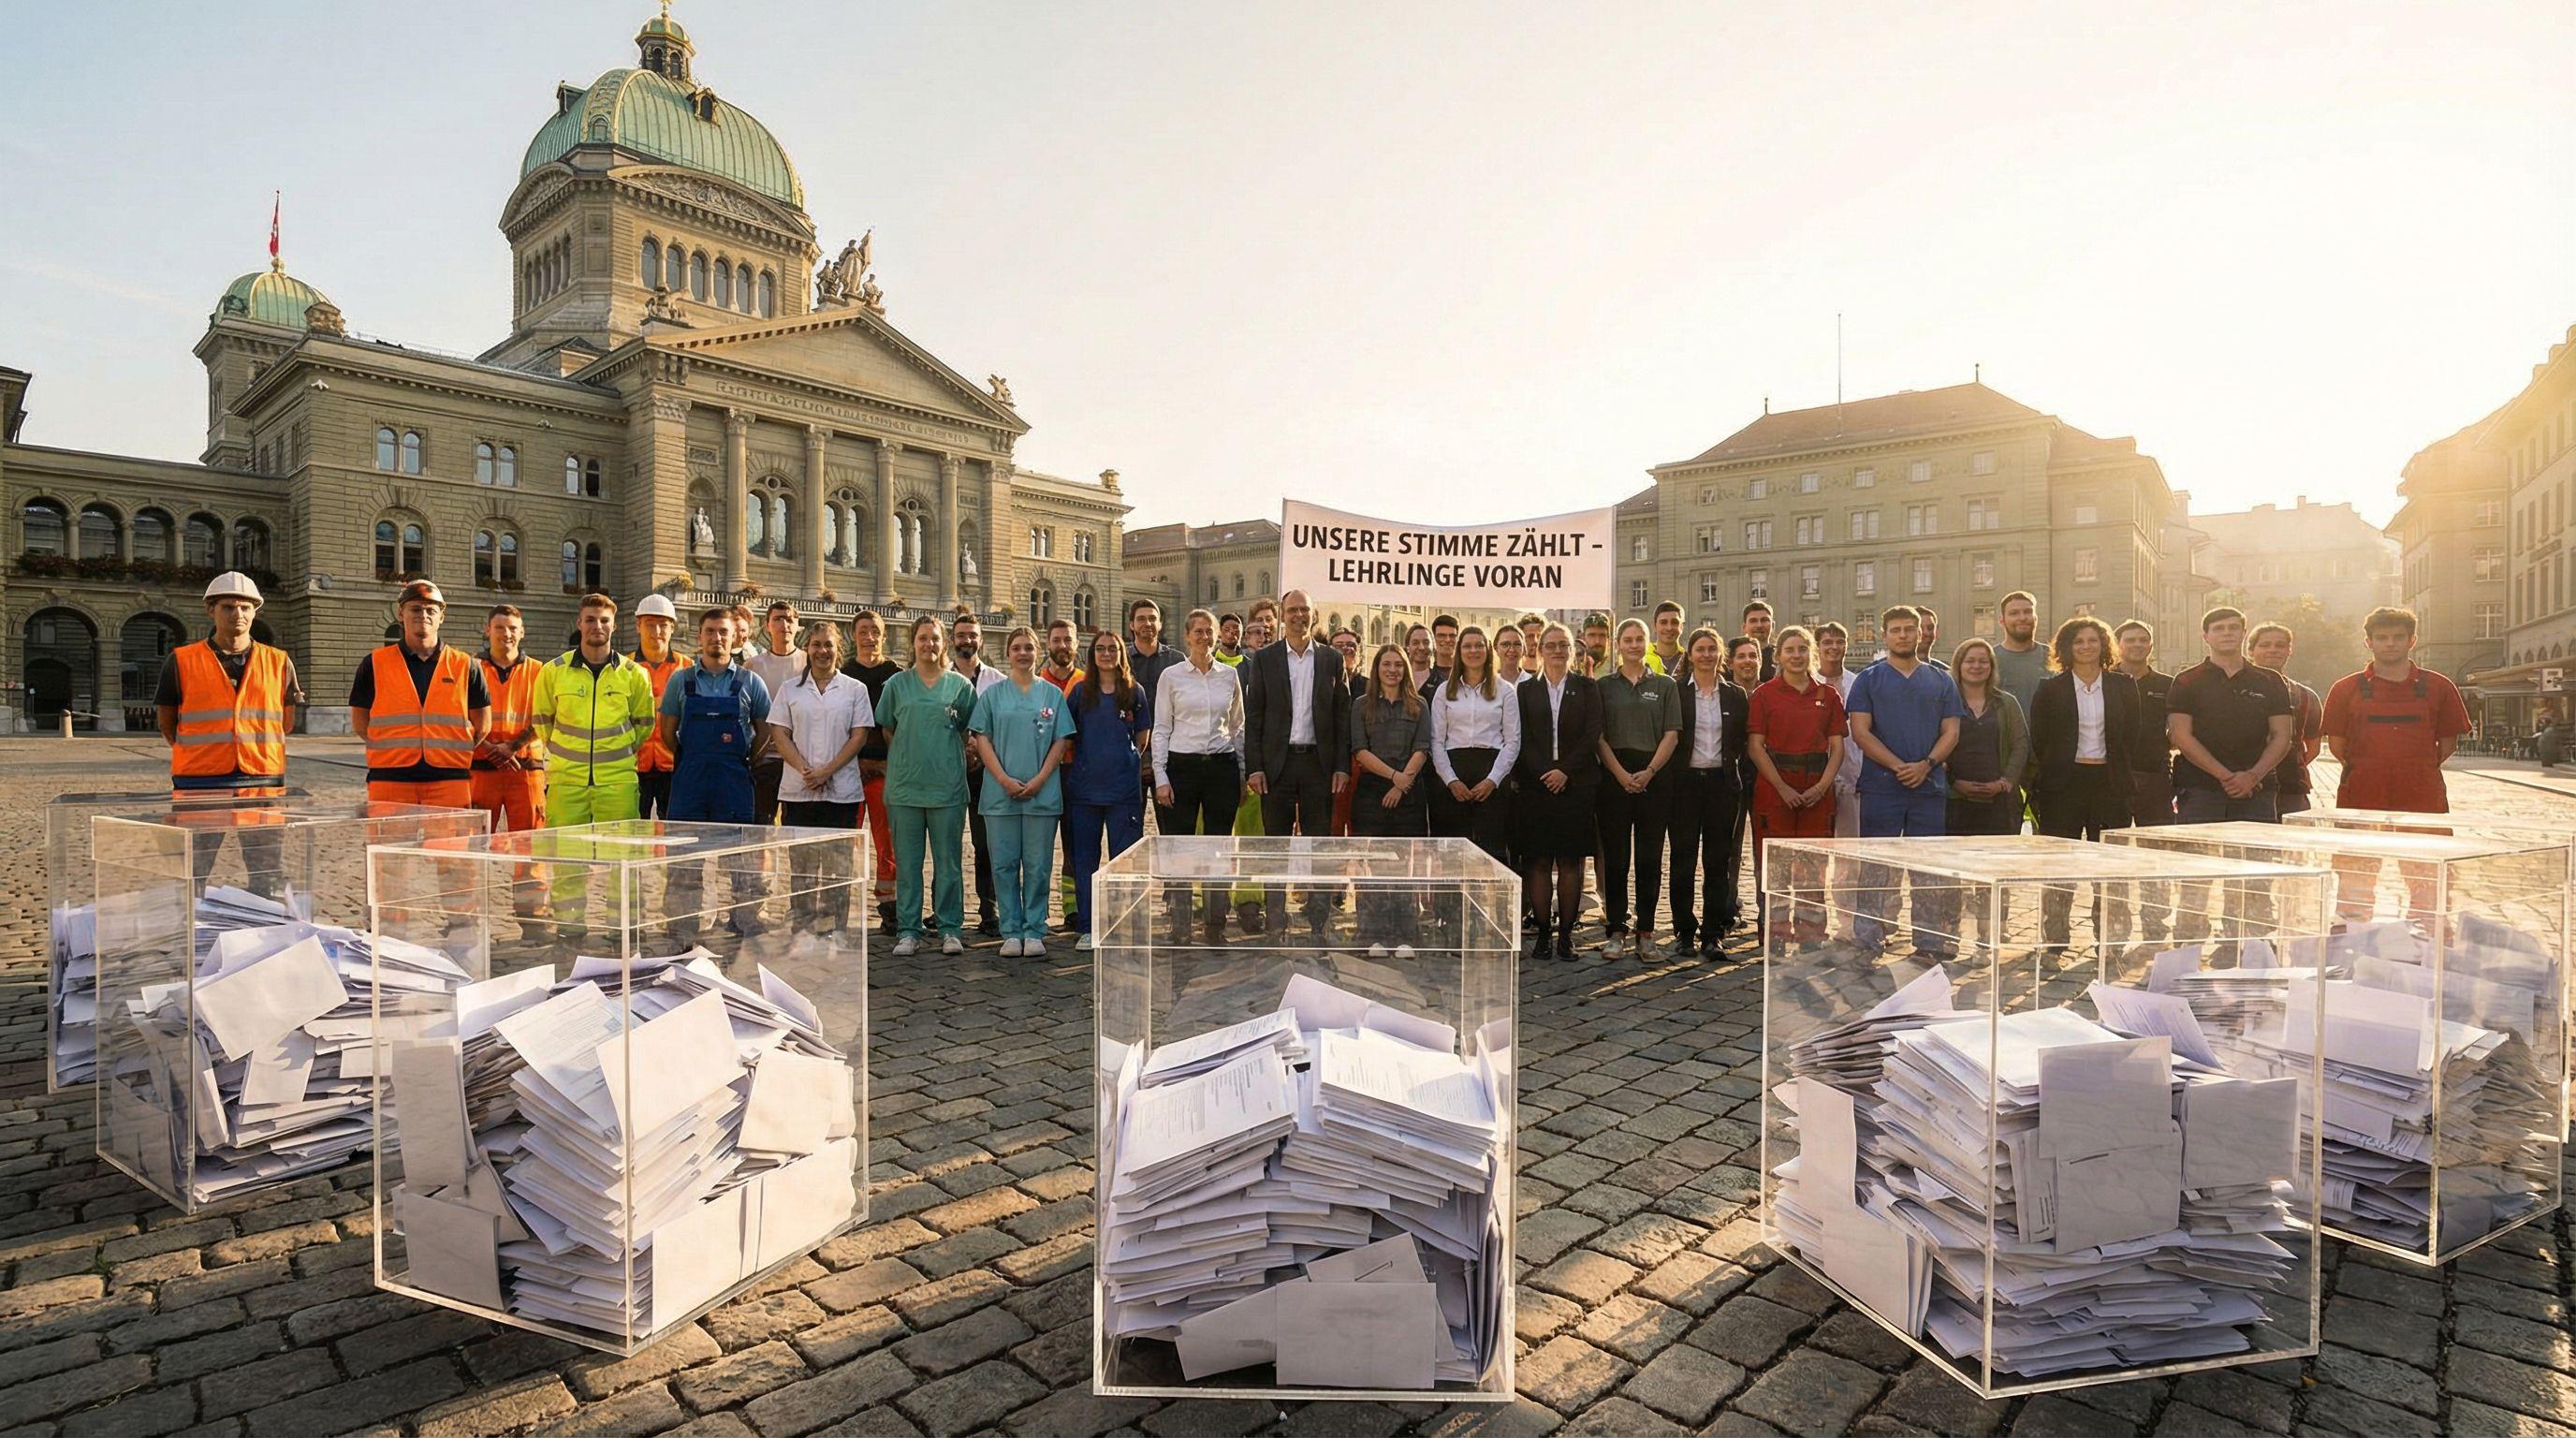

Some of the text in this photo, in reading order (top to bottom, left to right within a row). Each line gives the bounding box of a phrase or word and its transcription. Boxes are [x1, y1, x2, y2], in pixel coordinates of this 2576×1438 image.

[1293, 524, 1390, 553] UNSERE
[1398, 532, 1499, 557] STIMME
[1506, 527, 1586, 557] ZÄHLT
[1328, 558, 1562, 589] LEHRLINGE VORAN
